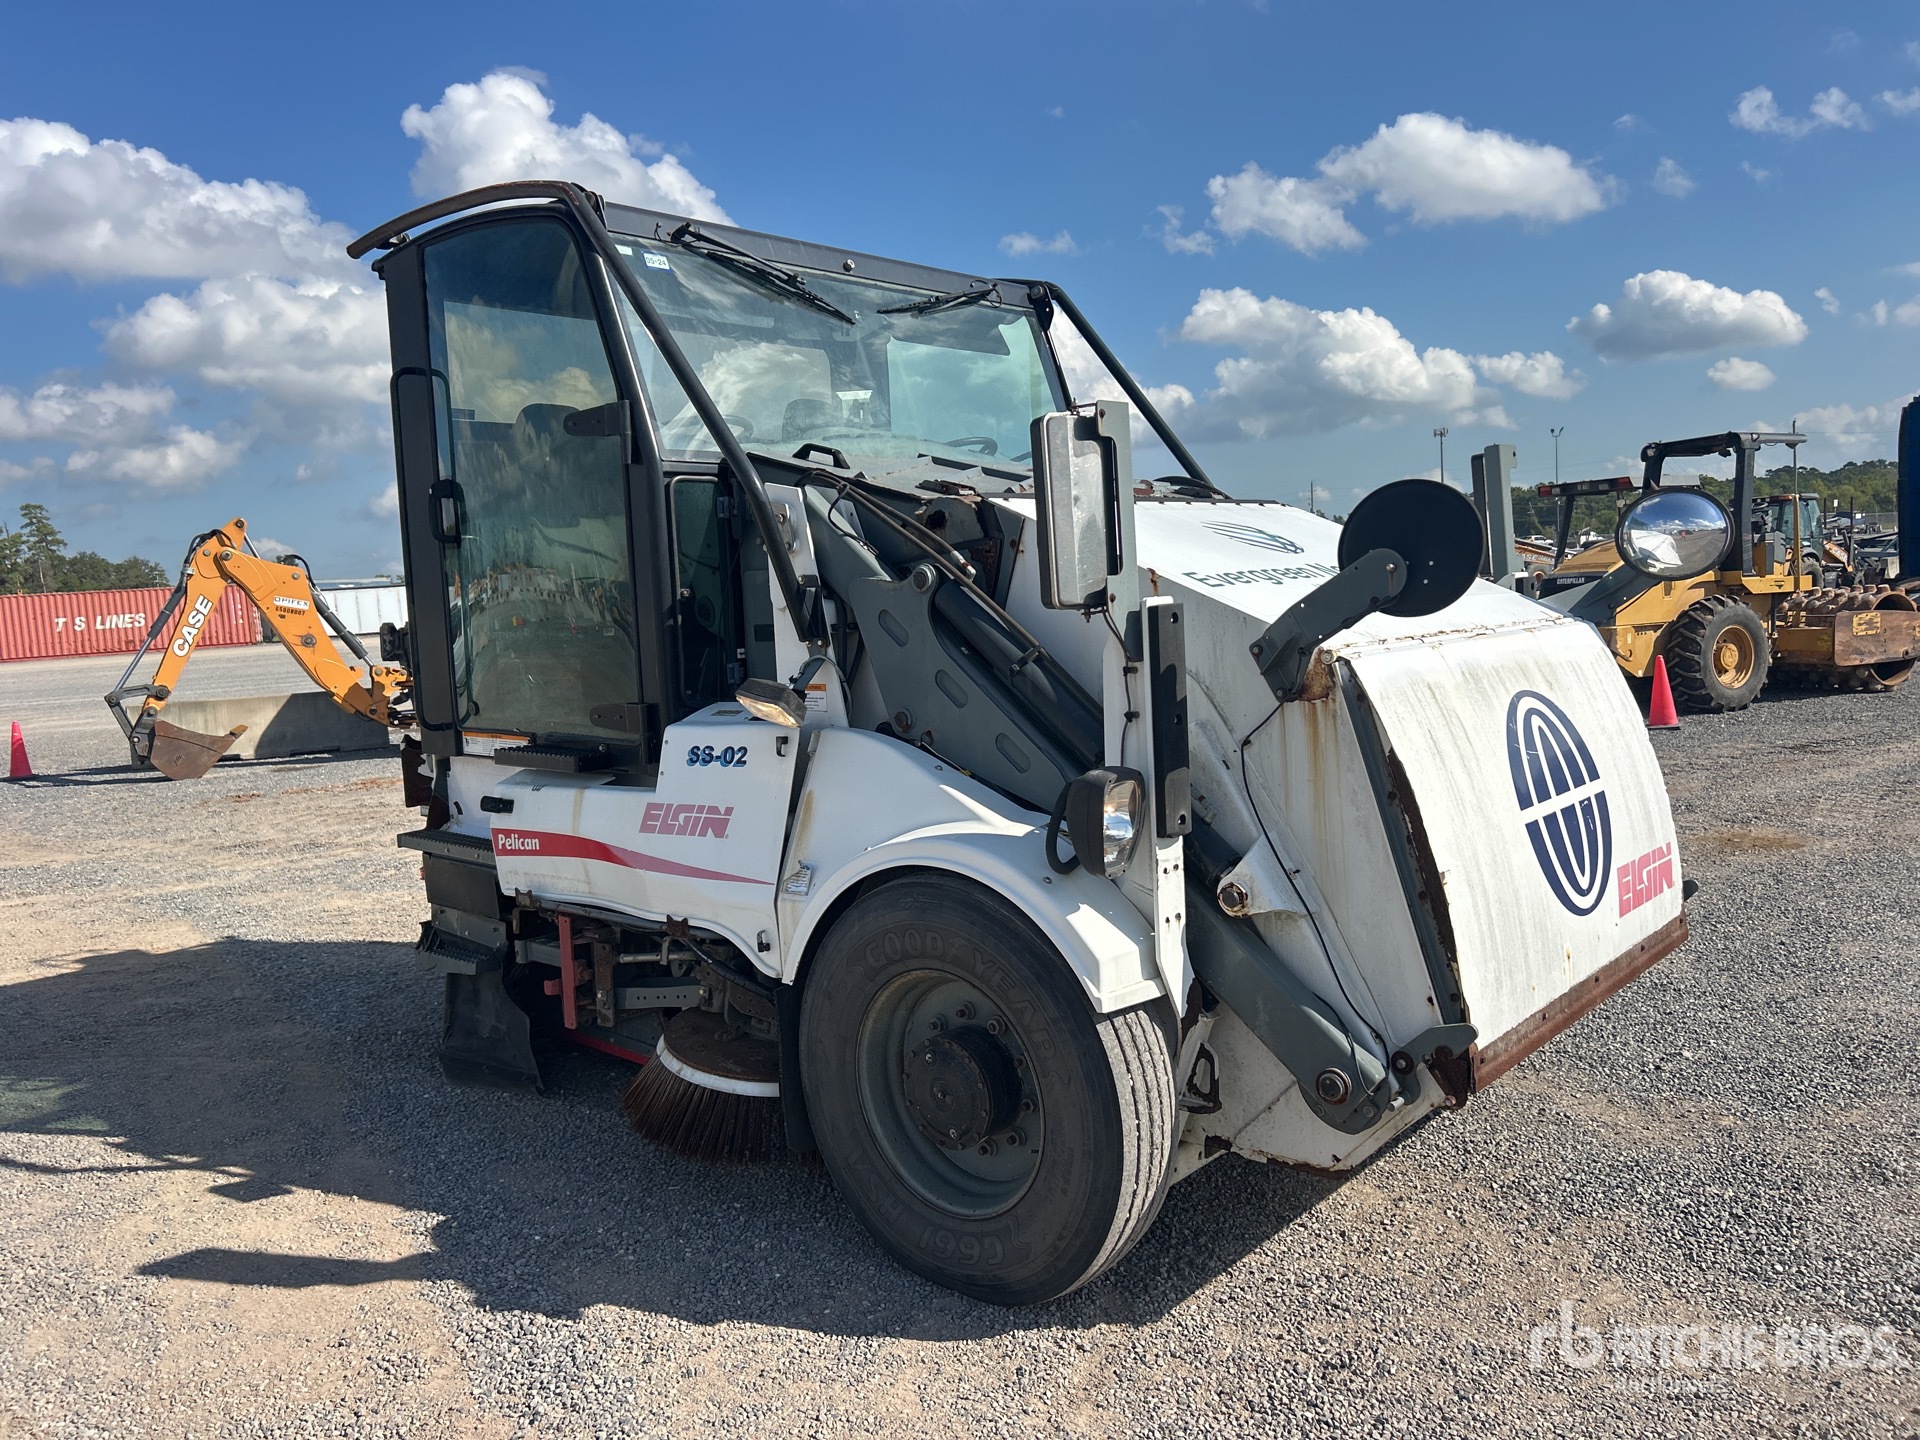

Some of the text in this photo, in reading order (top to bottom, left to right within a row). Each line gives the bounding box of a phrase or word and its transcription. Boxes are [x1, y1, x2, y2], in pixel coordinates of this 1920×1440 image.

[1182, 567, 1318, 588] Evergreen
[1556, 576, 1586, 585] CATERPILLAR
[274, 596, 309, 607] OPIFEX
[54, 613, 146, 632] T S LINES
[172, 594, 213, 657] CASE
[686, 745, 748, 768] SS-02
[638, 801, 735, 839] ELGIN
[497, 833, 540, 851] Pelican
[1616, 841, 1673, 919] ELGIN
